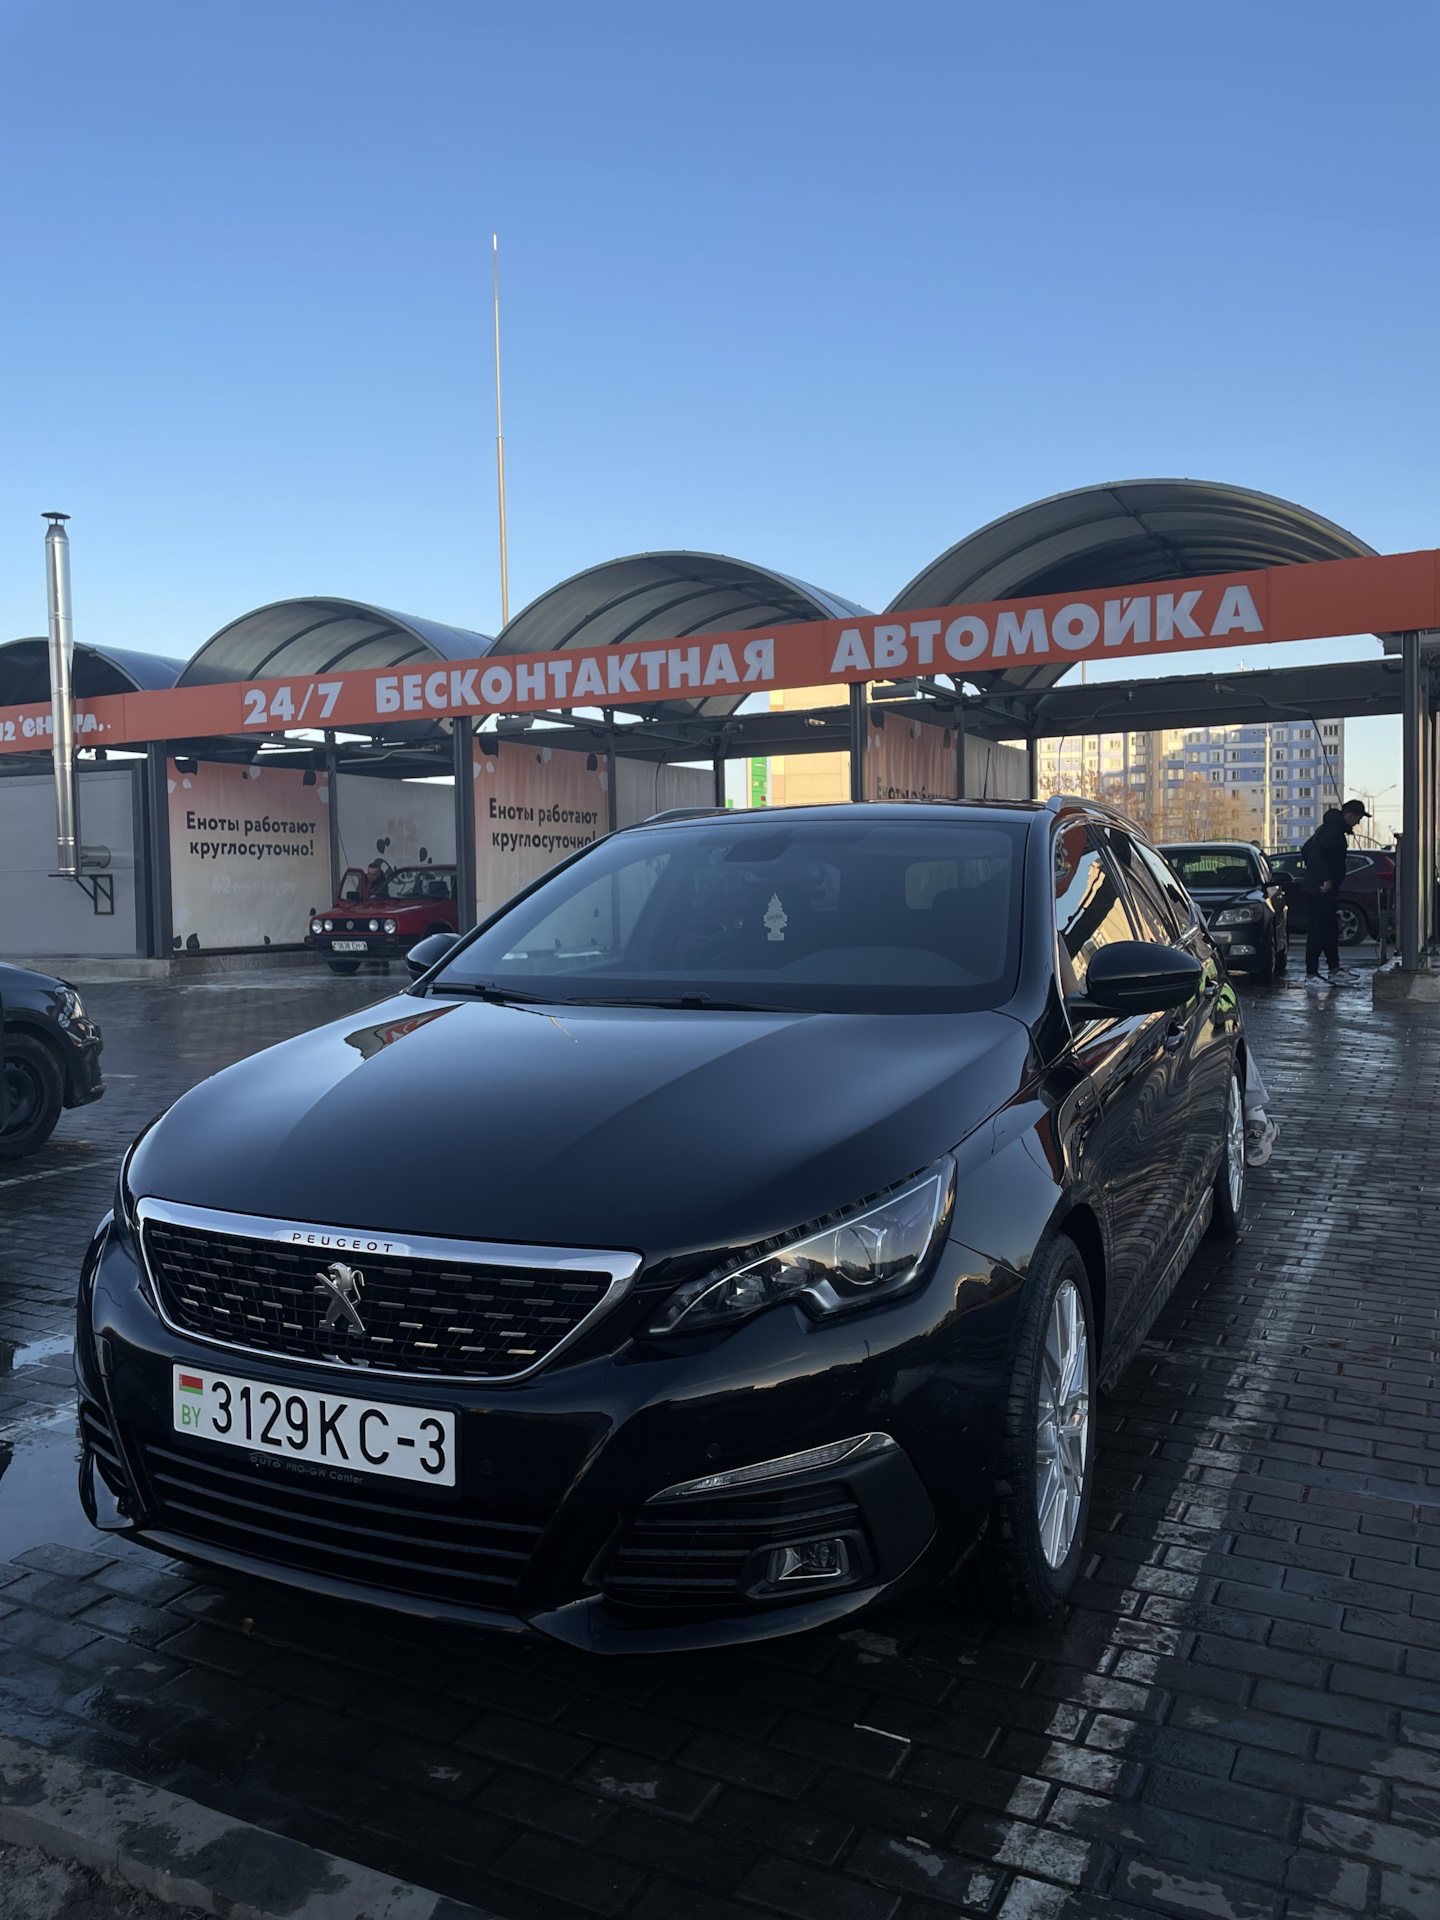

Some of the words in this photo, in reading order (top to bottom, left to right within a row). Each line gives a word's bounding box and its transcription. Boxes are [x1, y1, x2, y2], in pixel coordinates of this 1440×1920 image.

[243, 682, 343, 725] 24/7
[376, 639, 775, 713] БЕСКОНТАКТНАЯ
[830, 585, 1264, 673] АВТОМОЙКА
[0, 721, 16, 742] 2
[186, 811, 239, 831] Еноты
[244, 816, 316, 836] работают
[489, 797, 534, 821] Еноты
[538, 804, 598, 827] работают
[190, 839, 314, 860] круглосуточно!
[292, 1232, 393, 1252] PEUGEOT
[181, 1403, 201, 1428] BY
[328, 1471, 363, 1485] Center
